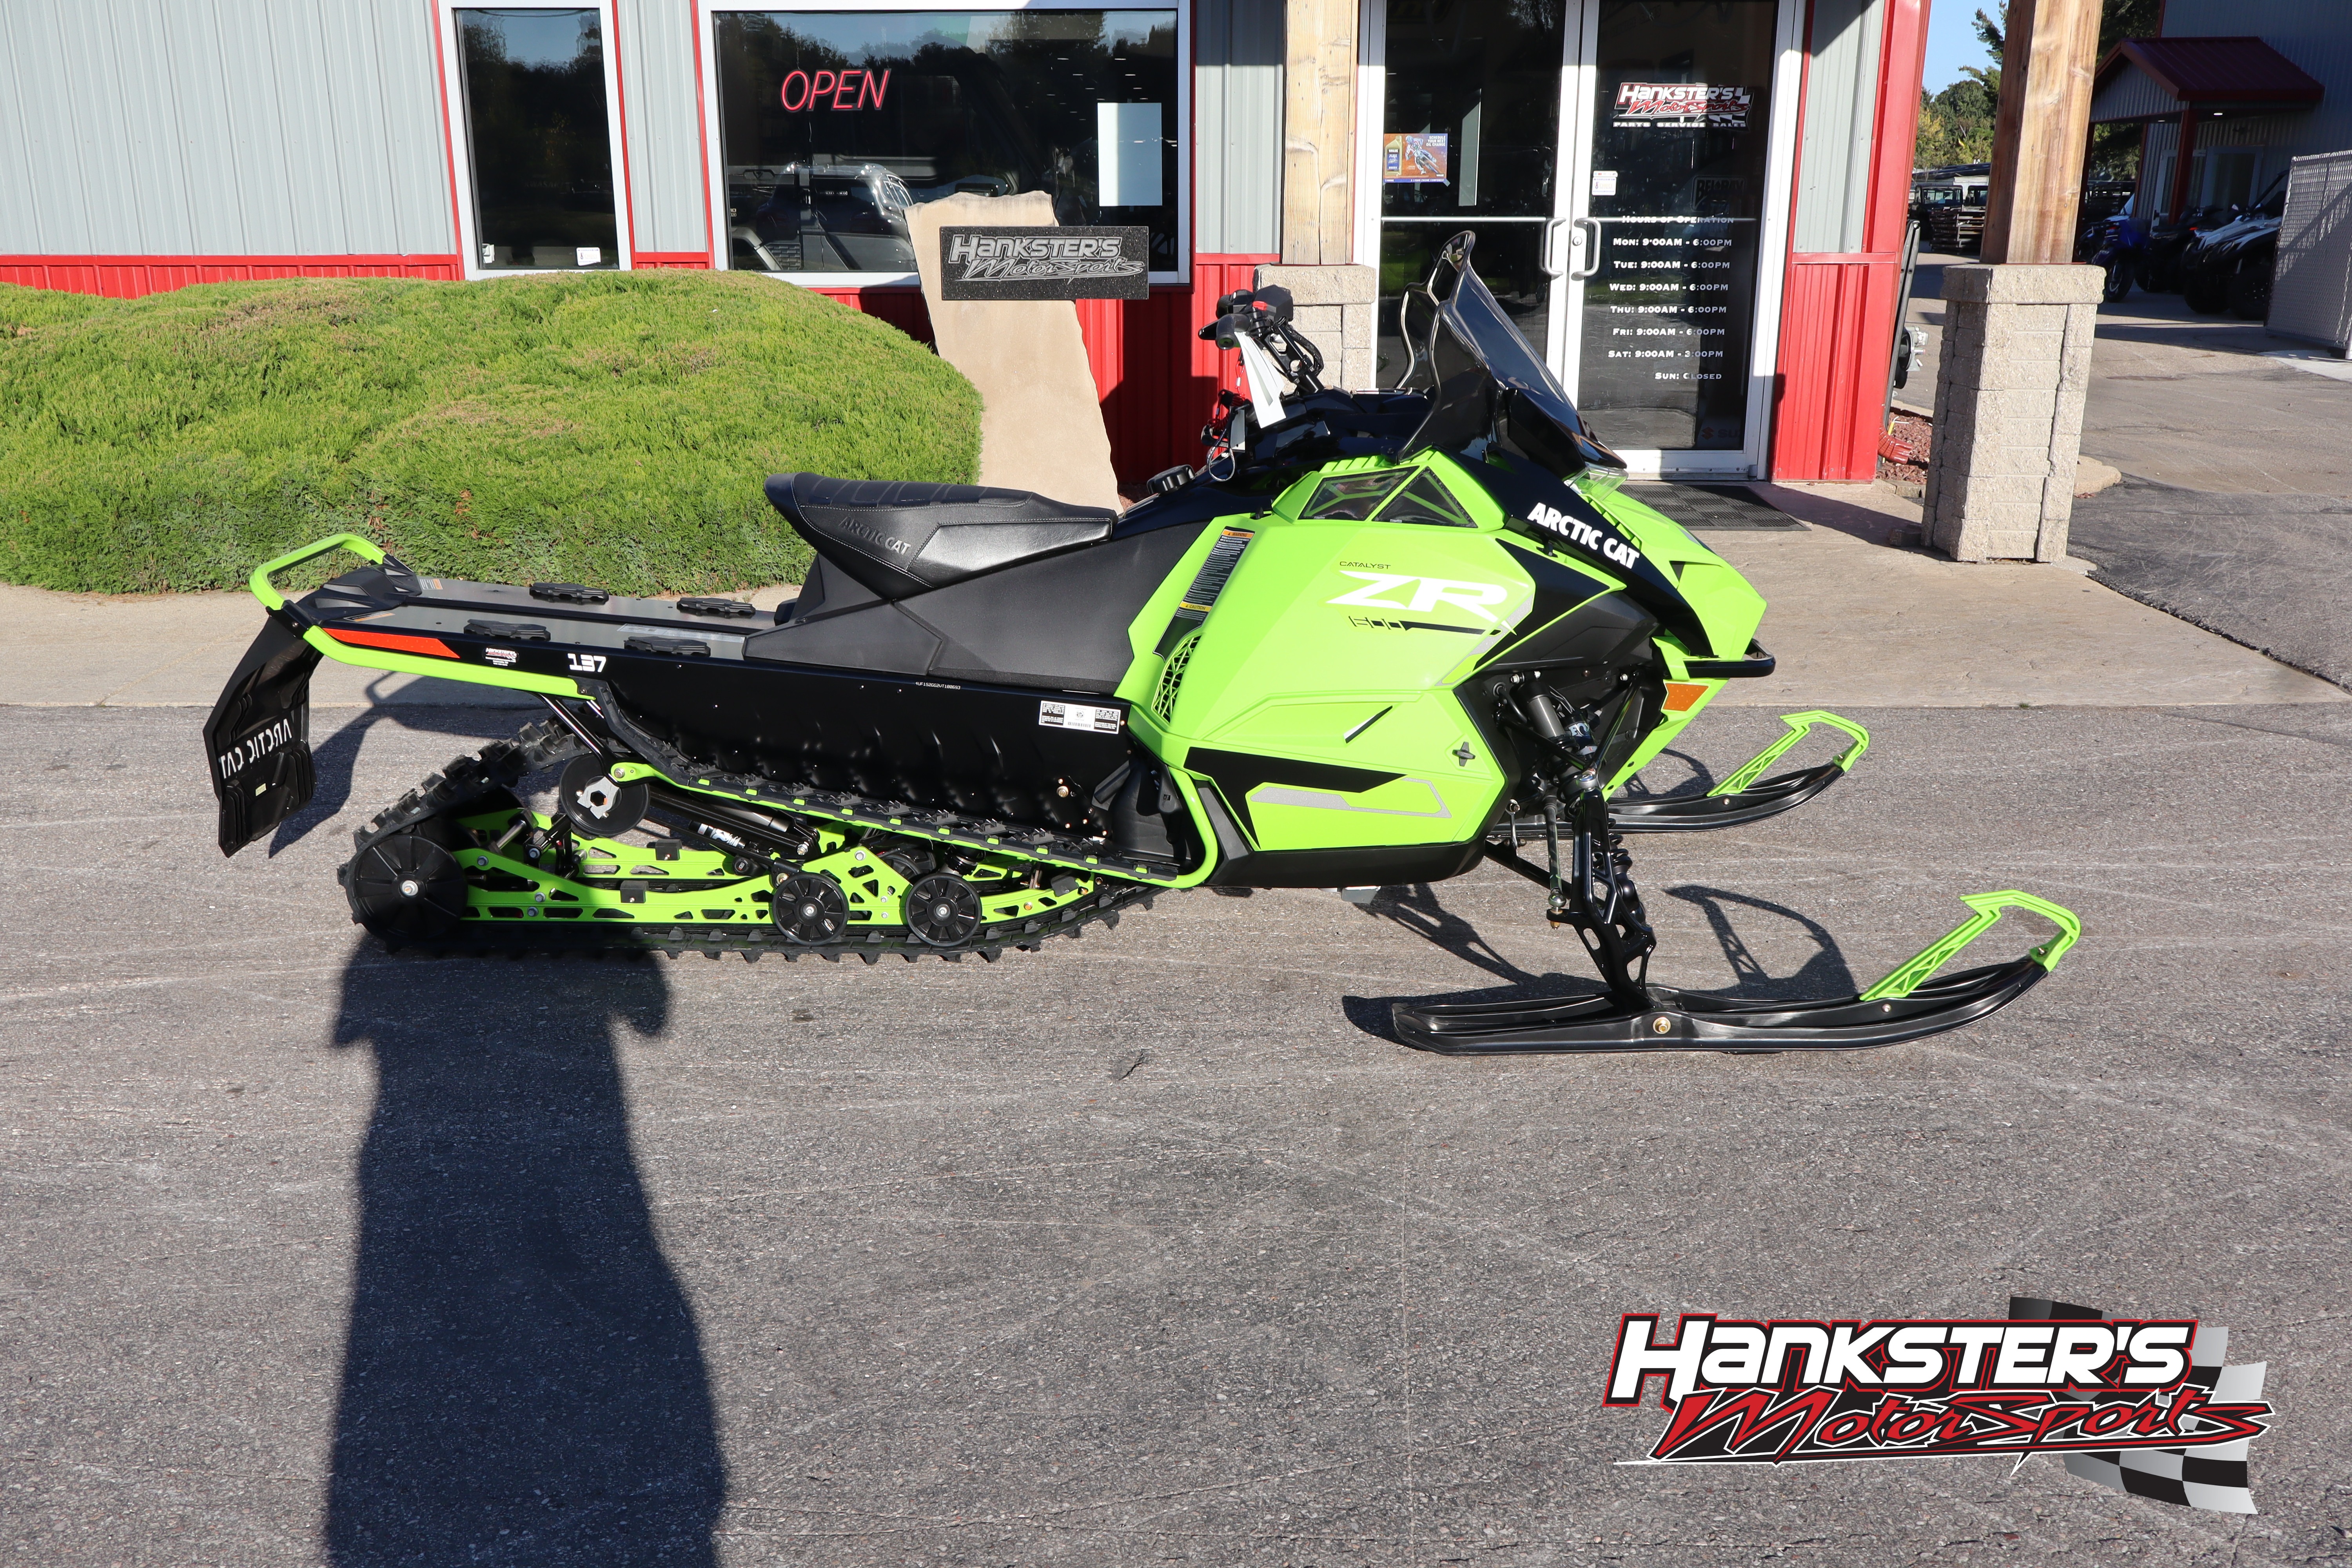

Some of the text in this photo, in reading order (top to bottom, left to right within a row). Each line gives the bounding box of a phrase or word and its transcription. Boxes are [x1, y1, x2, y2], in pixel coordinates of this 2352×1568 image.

[781, 69, 891, 112] OPEN
[838, 516, 912, 555] ARCTIC CAT
[1527, 502, 1640, 569] ARCTIC CAT
[1339, 561, 1391, 570] CATALYST
[1325, 570, 1517, 636] ZR
[567, 653, 606, 672] 137
